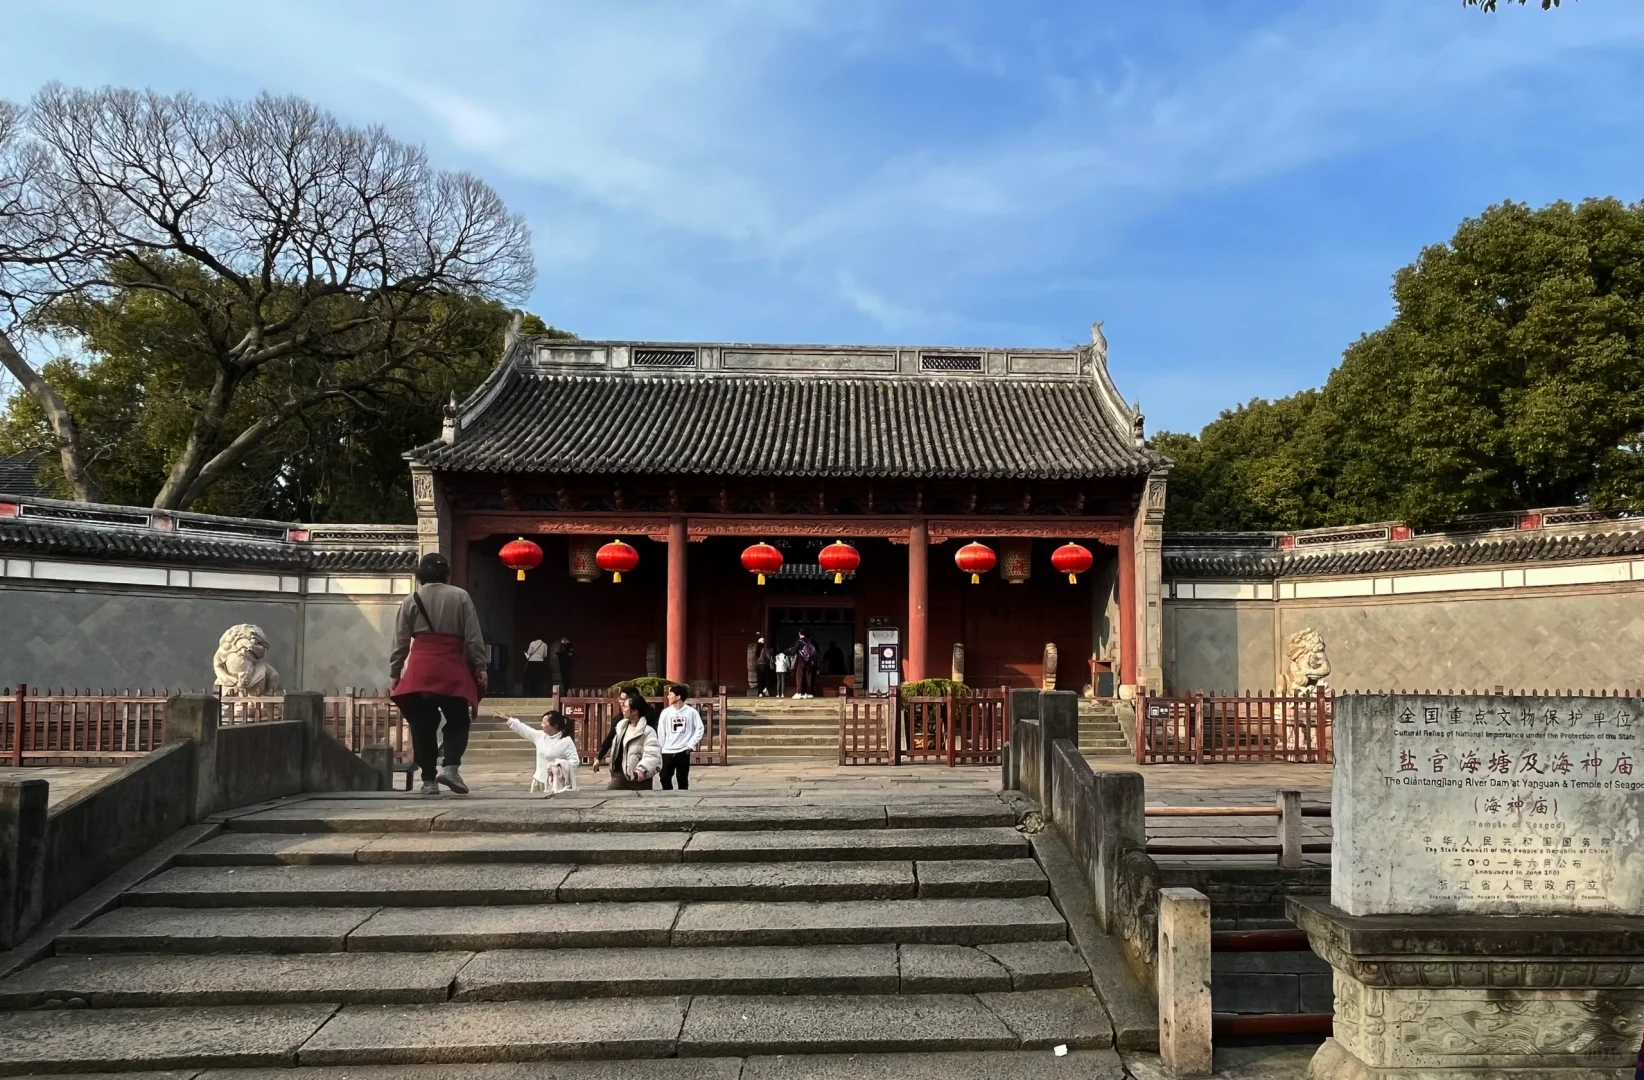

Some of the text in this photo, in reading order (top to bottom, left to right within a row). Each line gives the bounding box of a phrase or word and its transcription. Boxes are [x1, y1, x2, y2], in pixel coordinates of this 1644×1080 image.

[1398, 706, 1632, 728] 全国重点文物保护单位
[1394, 729, 1421, 737] Cultural
[1456, 730, 1484, 738] National
[1486, 731, 1524, 739] Importance
[1561, 732, 1595, 740] Protection
[1397, 748, 1633, 777] 盐官海塘及海神庙
[1385, 777, 1400, 786] The
[1466, 778, 1487, 787] River
[1490, 778, 1509, 787] Dam
[1522, 780, 1559, 789] Yanguan
[1562, 780, 1568, 788] &
[1571, 779, 1601, 788] Temple
[1604, 780, 1612, 789] of
[1474, 793, 1558, 816] （海神庙）
[1423, 836, 1611, 847] 中华人民共和国国务院
[1438, 880, 1598, 890] 浙江省人民政府立
